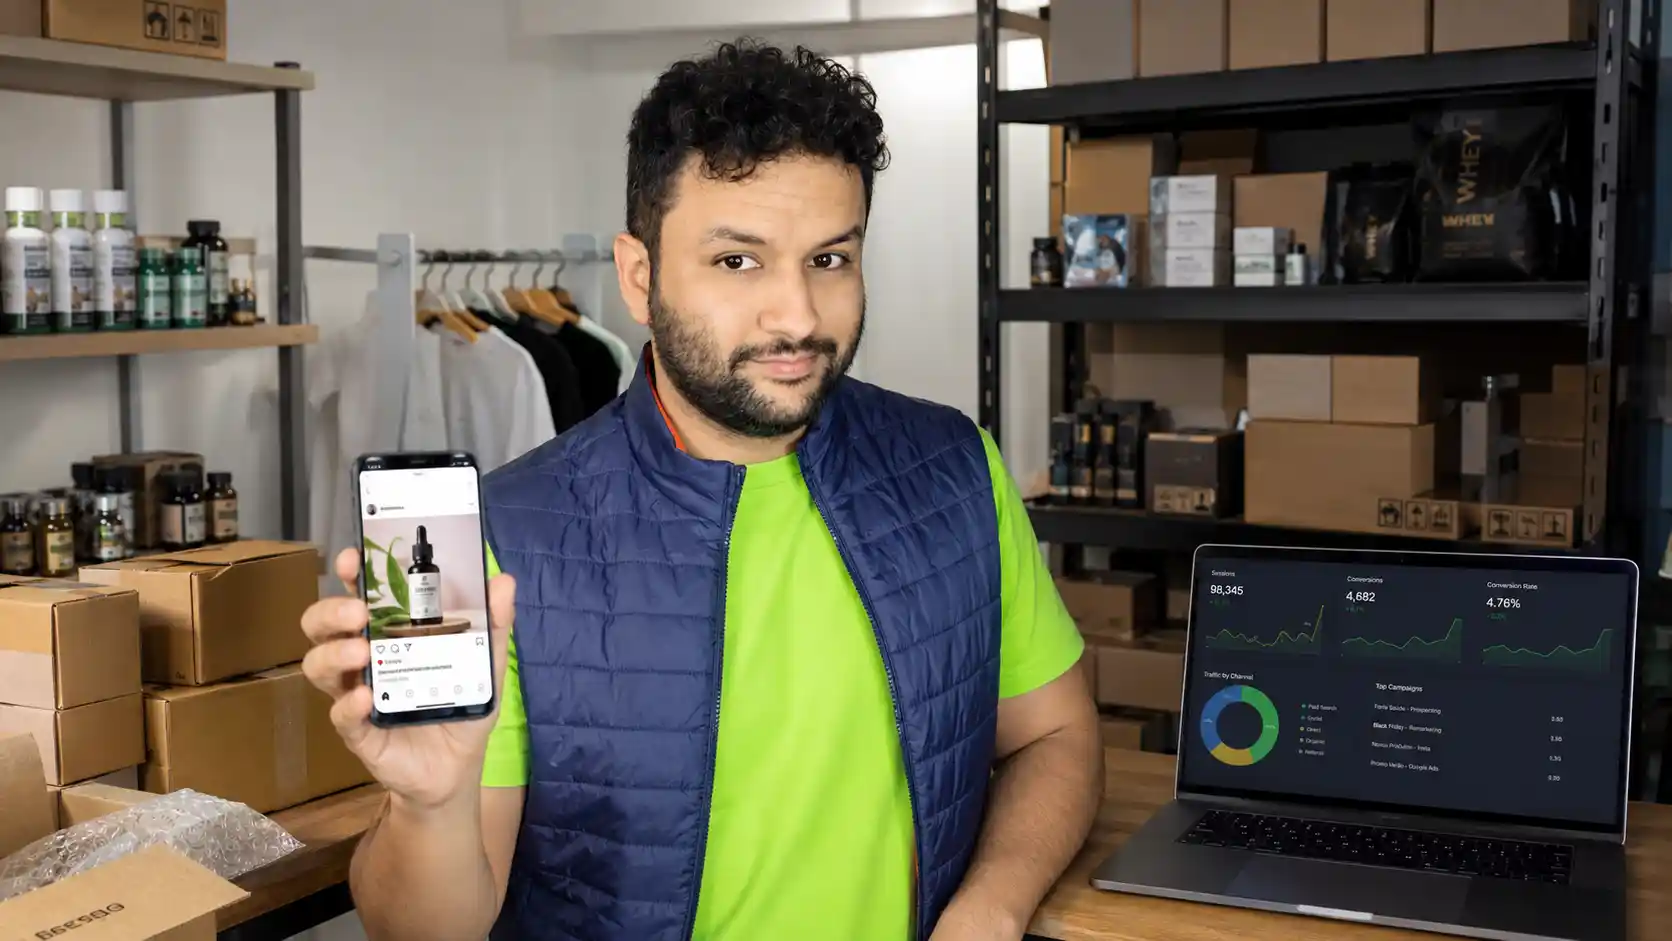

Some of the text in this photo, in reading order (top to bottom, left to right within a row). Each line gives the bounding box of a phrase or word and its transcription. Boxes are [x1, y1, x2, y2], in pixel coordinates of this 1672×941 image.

[1346, 575, 1384, 584] Conversions
[1486, 580, 1522, 590] Conversion
[1210, 584, 1244, 596] 98,345
[1345, 591, 1376, 603] 4,682
[1486, 597, 1521, 609] 4.76%
[1204, 670, 1221, 678] Traffic
[1230, 673, 1254, 681] Channel
[1375, 682, 1424, 693] Top Campaigns
[1388, 723, 1404, 732] Friday
